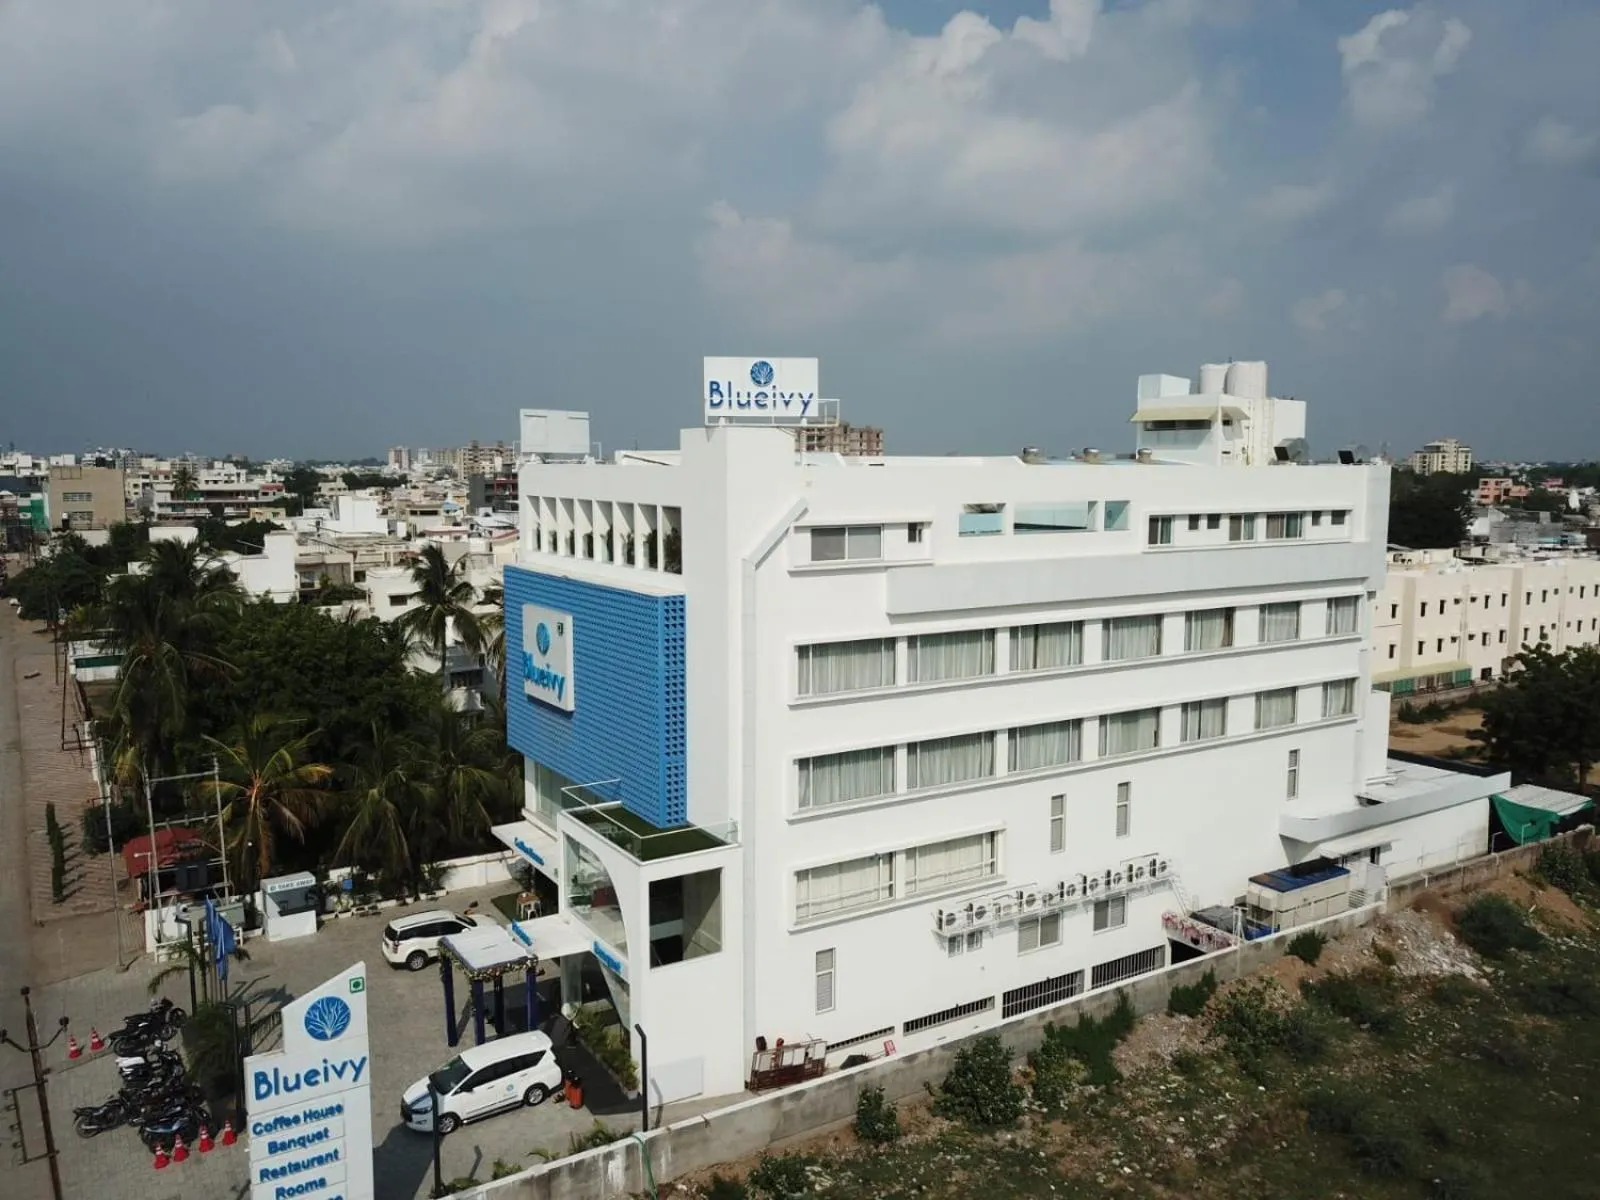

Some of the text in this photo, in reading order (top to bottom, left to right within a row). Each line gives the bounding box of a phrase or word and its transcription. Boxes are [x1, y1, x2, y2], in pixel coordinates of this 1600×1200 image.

[709, 380, 814, 416] Blueivy
[254, 1056, 367, 1101] Blueivy
[252, 1103, 344, 1136] Coffee House
[267, 1127, 330, 1155] Banquet
[259, 1148, 340, 1183] Restaurant
[275, 1177, 328, 1200] Rooms
